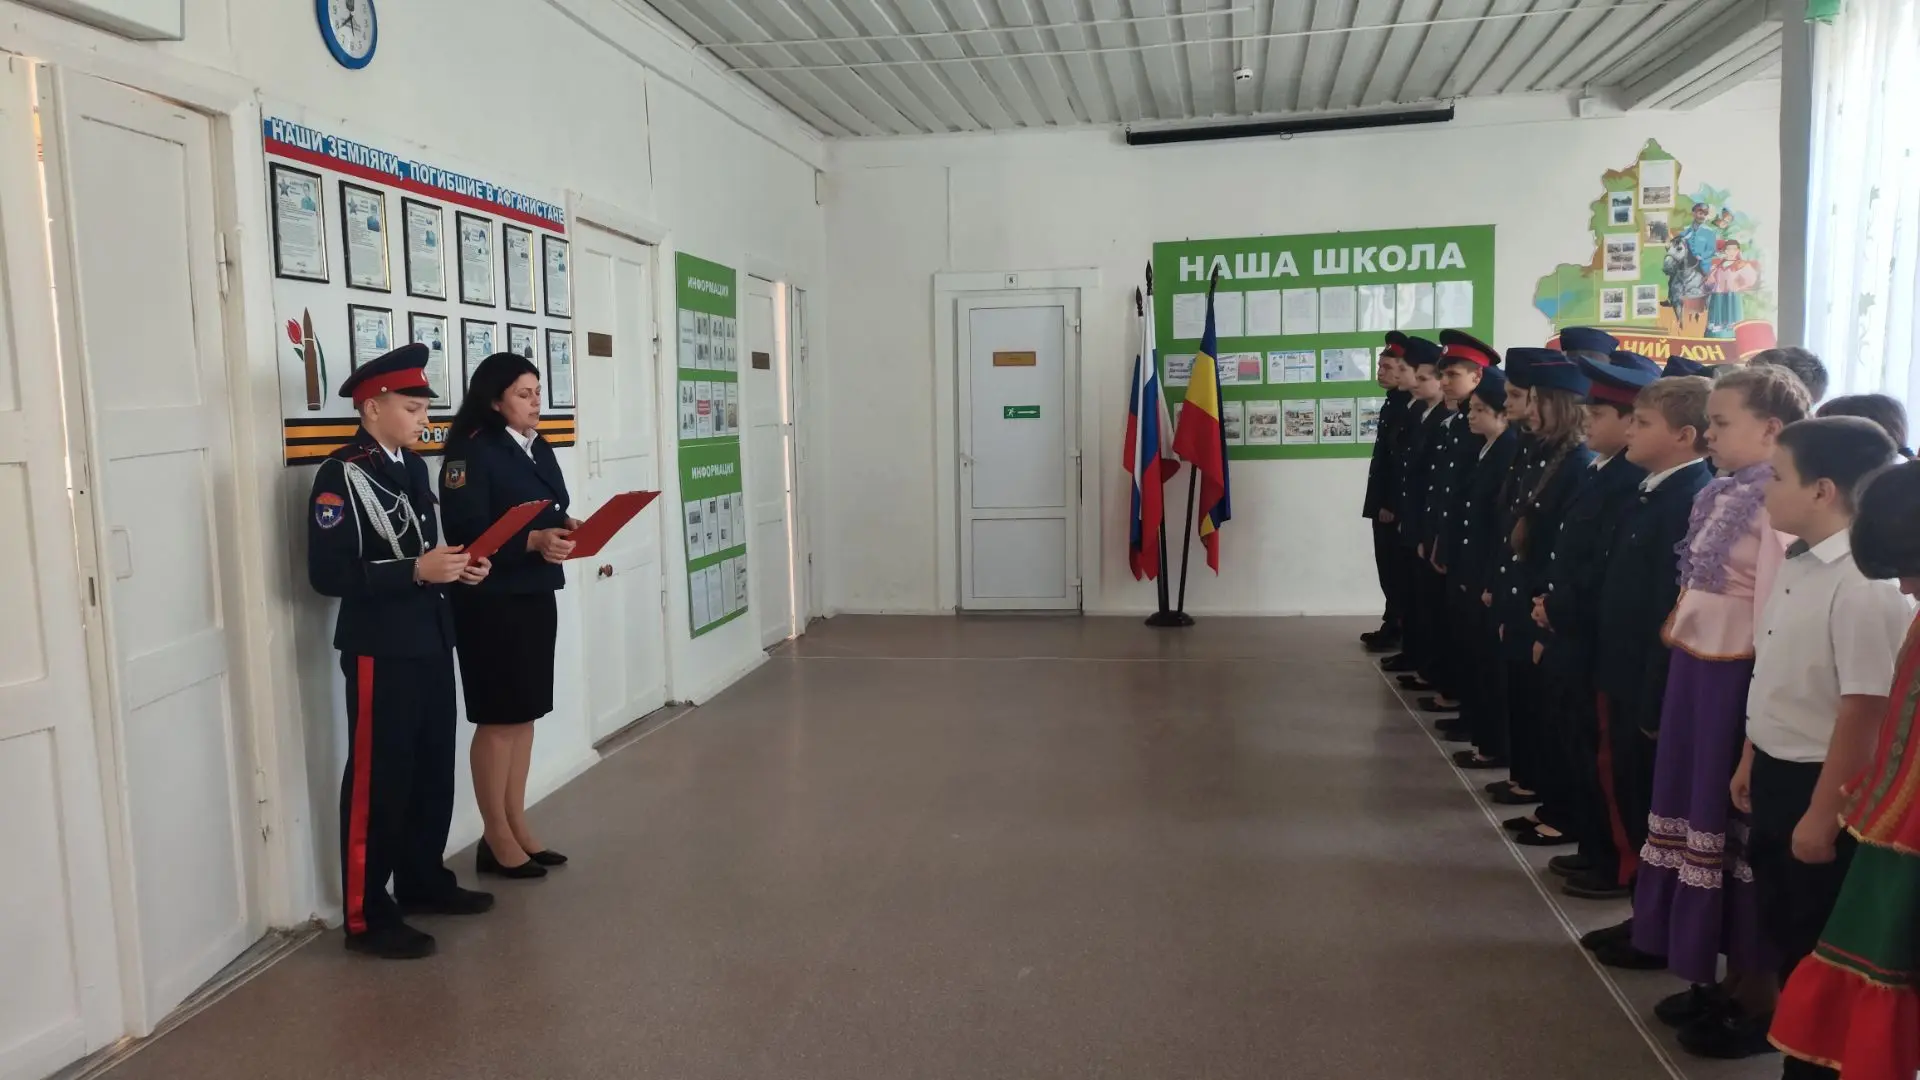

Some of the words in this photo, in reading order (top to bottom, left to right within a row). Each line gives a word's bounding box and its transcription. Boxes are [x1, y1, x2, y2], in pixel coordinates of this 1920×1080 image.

[271, 117, 323, 153] НАШИ
[327, 135, 403, 179] ЗЕМЛЯКИ,
[409, 160, 483, 199] ПОГИБШИЕ
[486, 183, 494, 202] В
[497, 187, 565, 225] АФГАНИСТАНЕ
[1179, 251, 1300, 282] НАША
[1313, 242, 1466, 276] ШКОЛА
[687, 275, 729, 298] ИНФОРМАЦИЯ
[691, 462, 734, 480] ИНФОРМАЦИЯ
